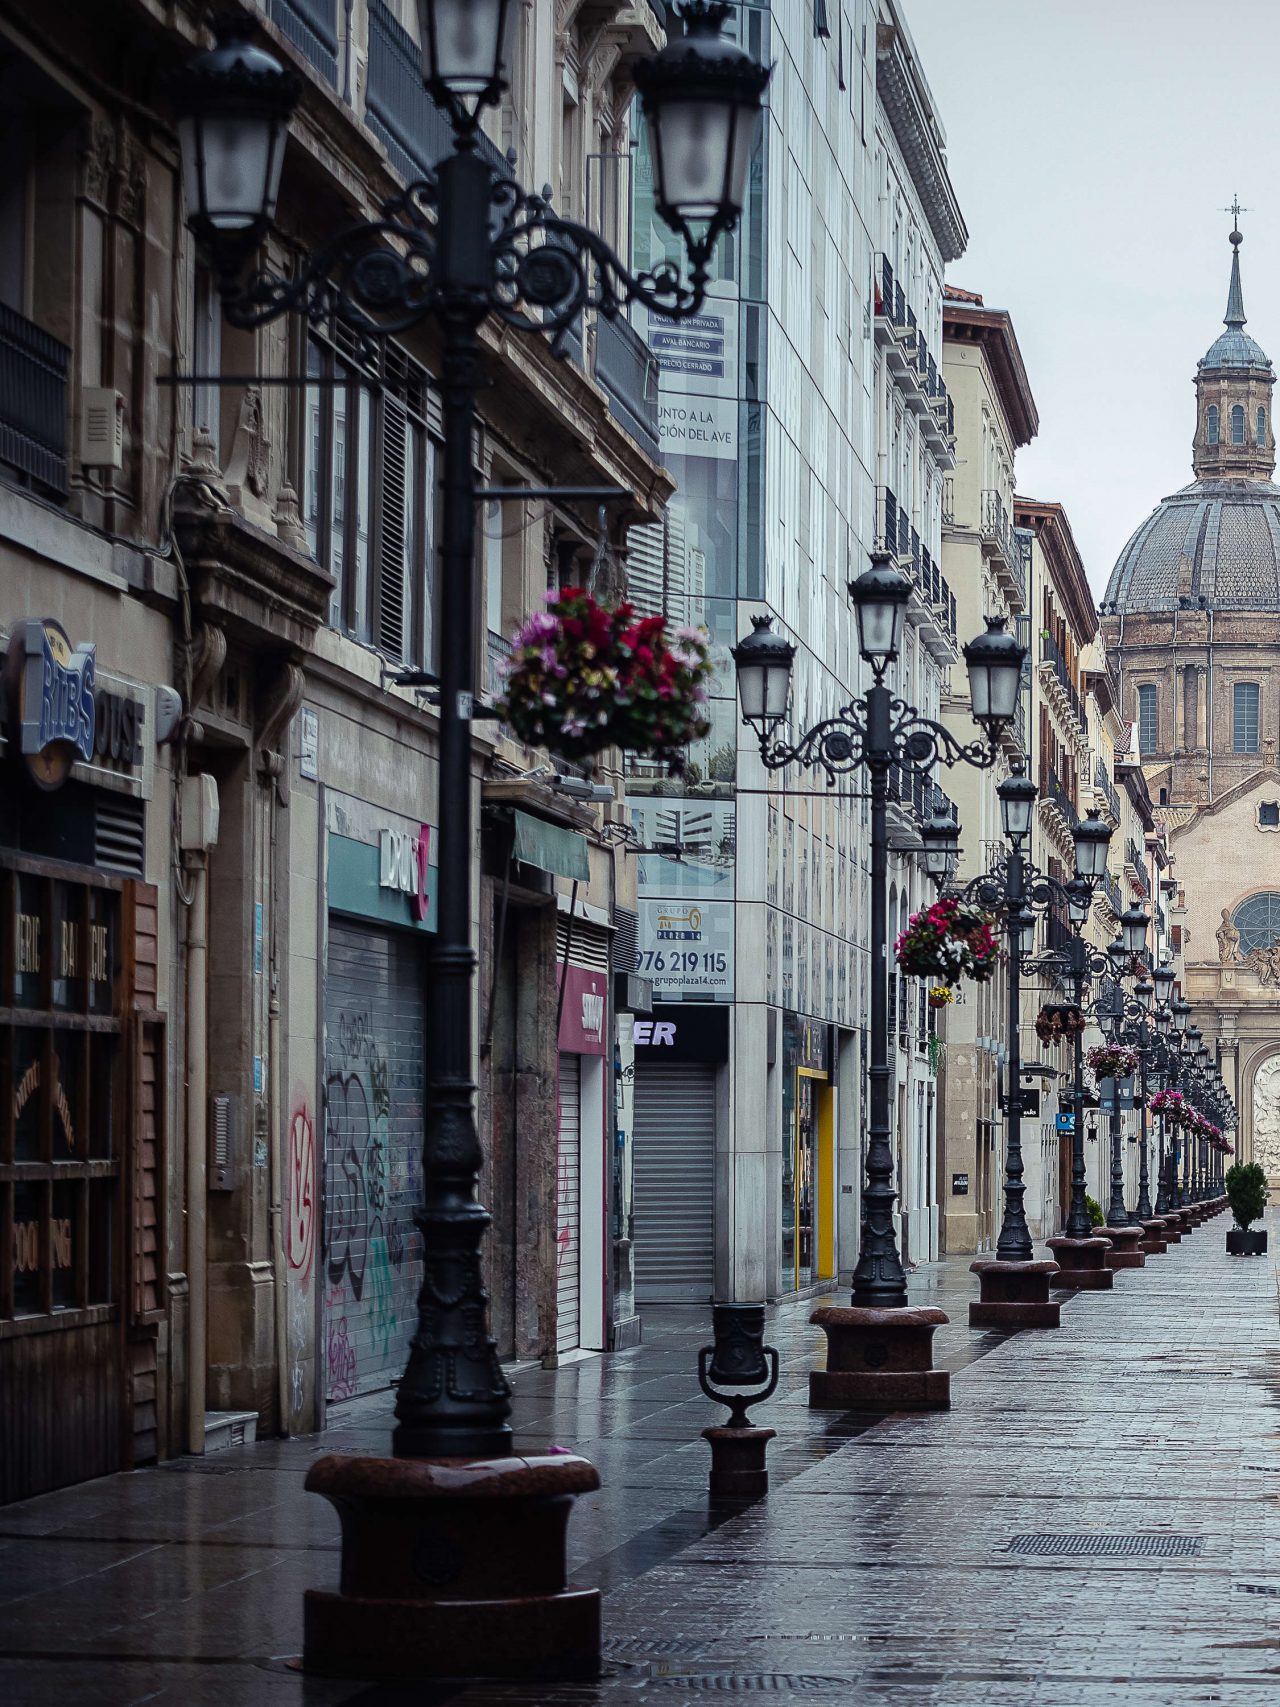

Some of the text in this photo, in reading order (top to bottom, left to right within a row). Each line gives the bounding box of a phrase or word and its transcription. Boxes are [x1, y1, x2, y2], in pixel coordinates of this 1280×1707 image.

[693, 319, 719, 329] PRIVADA
[662, 337, 710, 350] AVAL BANCARIO
[660, 359, 712, 372] PRECIO CERRADO
[689, 411, 698, 423] A
[700, 411, 714, 424] LA
[688, 428, 710, 442] DEL
[711, 431, 732, 444] AVE
[40, 655, 96, 762] RIBS
[638, 951, 727, 973] 976 219 115
